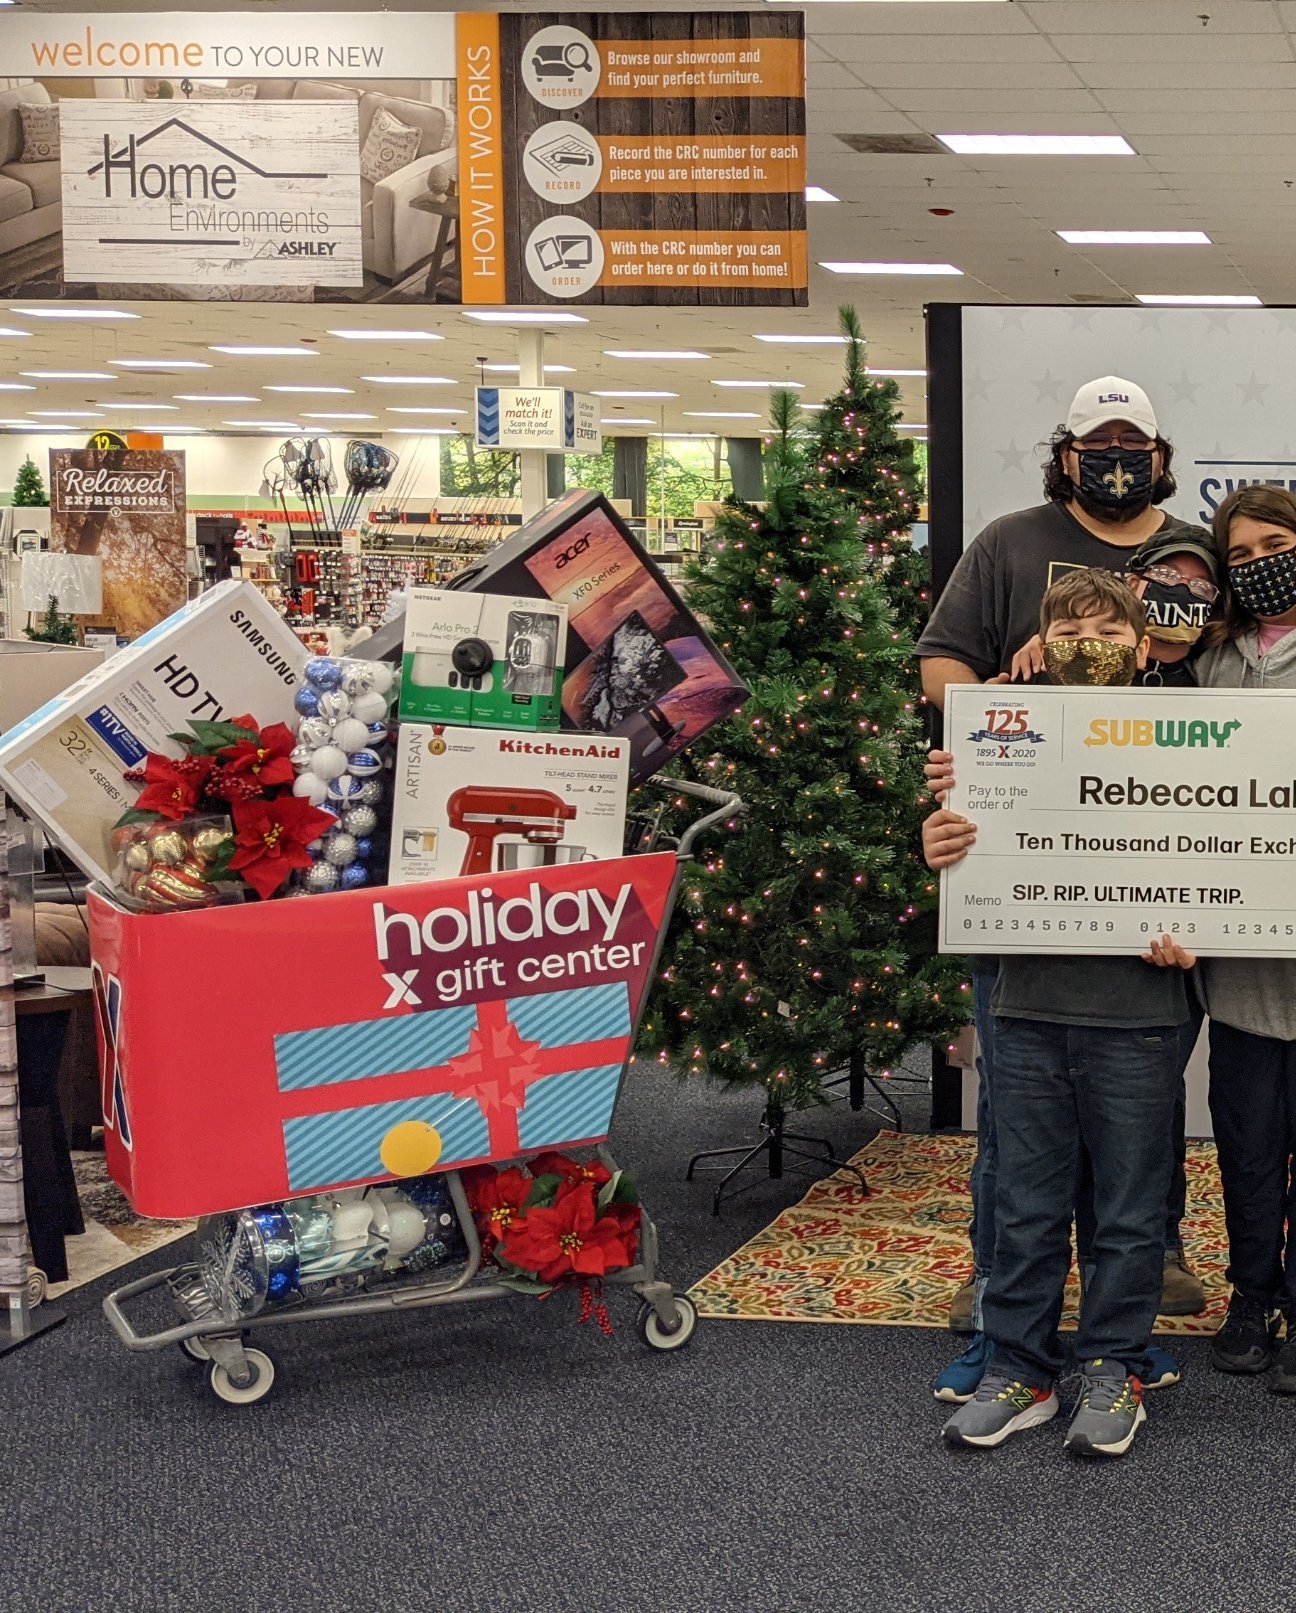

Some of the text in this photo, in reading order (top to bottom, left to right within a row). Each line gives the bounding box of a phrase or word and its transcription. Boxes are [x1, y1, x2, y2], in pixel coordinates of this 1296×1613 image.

[31, 26, 384, 68] welcome TO YOUR NEW
[608, 49, 760, 65] Browse our showroom and
[608, 71, 762, 88] find your perfect furniture.
[542, 87, 583, 97] DISCOVER
[467, 45, 496, 276] HOW IT WORKS
[610, 145, 798, 160] Record the CRC number for each
[104, 134, 237, 199] Home
[610, 166, 767, 182] piece you are interested in.
[545, 181, 581, 190] RECORD
[170, 203, 329, 234] Environments
[243, 234, 337, 256] by ASHLEY
[611, 241, 781, 258] With the CRC number you can
[612, 262, 788, 276] order here or do it from home!
[552, 276, 581, 286] ORDER
[515, 397, 541, 407] We'll
[1098, 393, 1129, 404] LSU
[505, 408, 552, 419] match it!
[510, 420, 526, 428] Scan
[534, 420, 548, 428] and
[537, 428, 555, 437] price
[576, 427, 597, 440] EXPERT
[63, 468, 168, 495] Relaxed
[65, 496, 168, 506] EXPRESSIONS
[554, 532, 591, 569] acer
[591, 562, 621, 587] Series
[431, 622, 479, 635] Arlo Pro 2
[230, 610, 296, 685] SAMSUNG
[154, 654, 199, 698] HD
[985, 709, 1030, 734] 125
[1083, 718, 1243, 748] SUBWAY
[499, 739, 621, 759] KitchenAid
[976, 748, 996, 757] 1895
[1012, 749, 1036, 758] 2020
[406, 732, 422, 800] ARTISAN
[93, 772, 121, 800] SERIES
[566, 784, 572, 792] 5
[588, 785, 602, 793] 4.7
[968, 784, 1028, 799] Pay to the
[1079, 775, 1238, 808] Rebecca
[968, 799, 1014, 810] order of
[1016, 832, 1054, 851] Ten
[1061, 833, 1170, 853] Thousand
[1178, 836, 1243, 854] Dollar
[965, 884, 1245, 906] Memo SIP. RIP. ULTIMATE TRIP.
[373, 882, 632, 960] holiday
[436, 957, 506, 1002] gift
[517, 942, 645, 982] center
